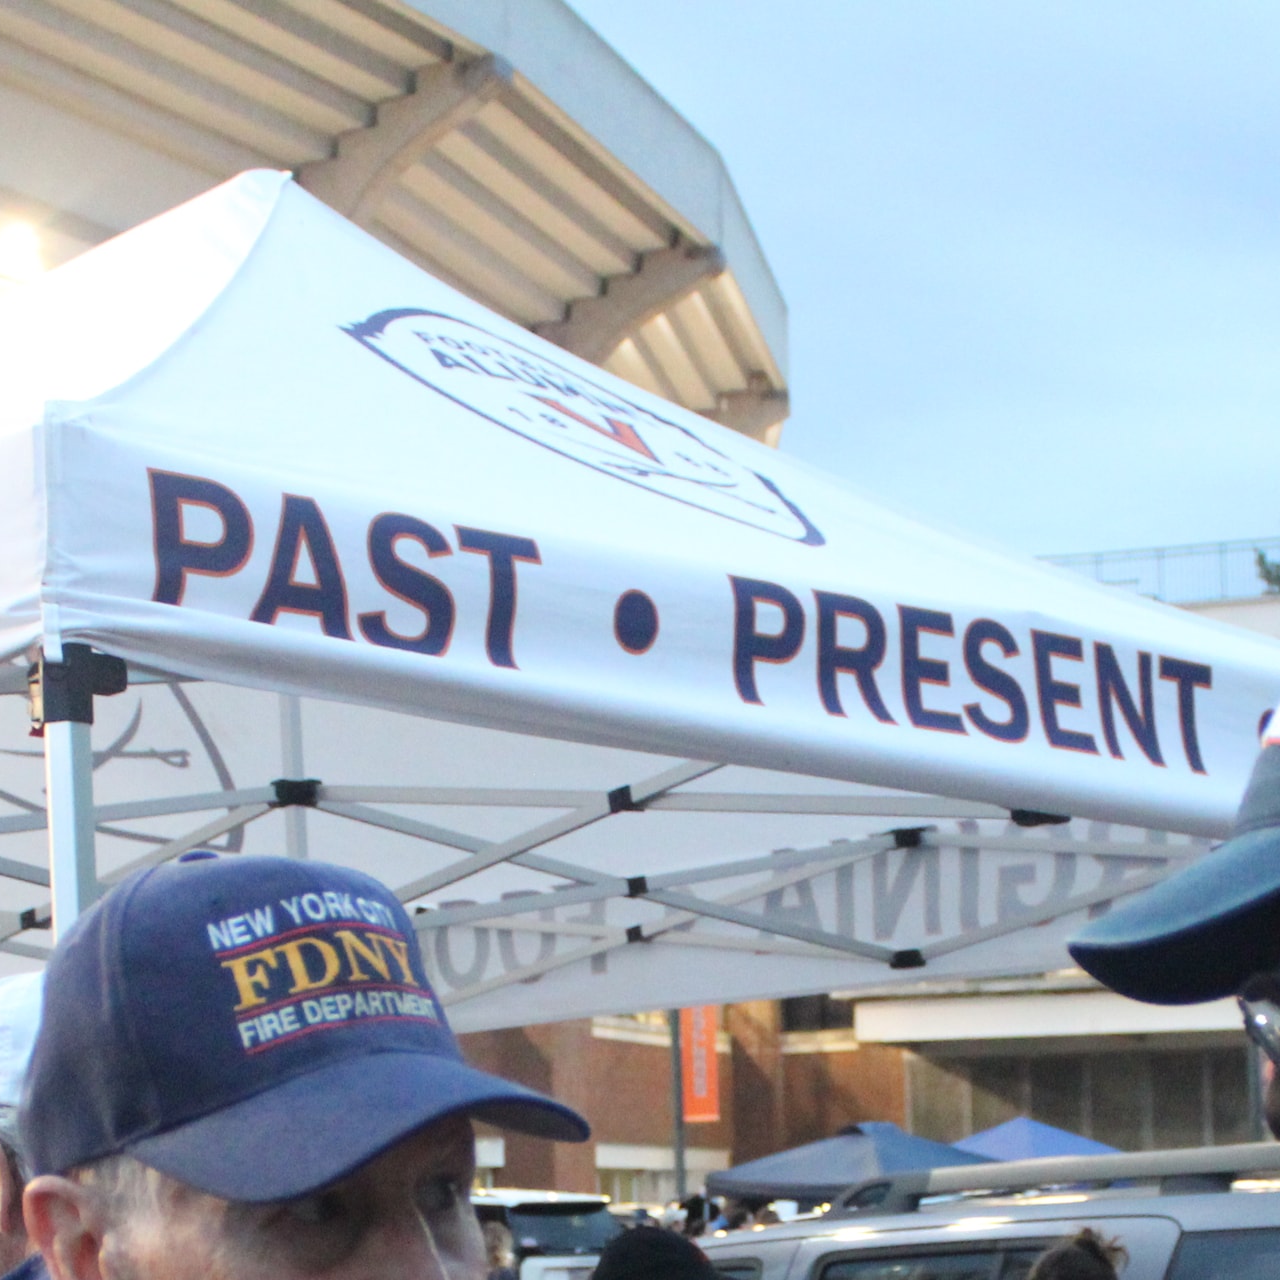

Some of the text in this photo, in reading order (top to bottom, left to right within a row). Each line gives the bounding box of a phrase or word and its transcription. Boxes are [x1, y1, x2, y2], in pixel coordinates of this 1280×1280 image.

[146, 466, 1214, 775] PAST PRESENT
[206, 891, 398, 951] NEW YORK CITY
[221, 928, 420, 1012] FDNY
[237, 990, 437, 1049] FIRE DEPARTMENT
